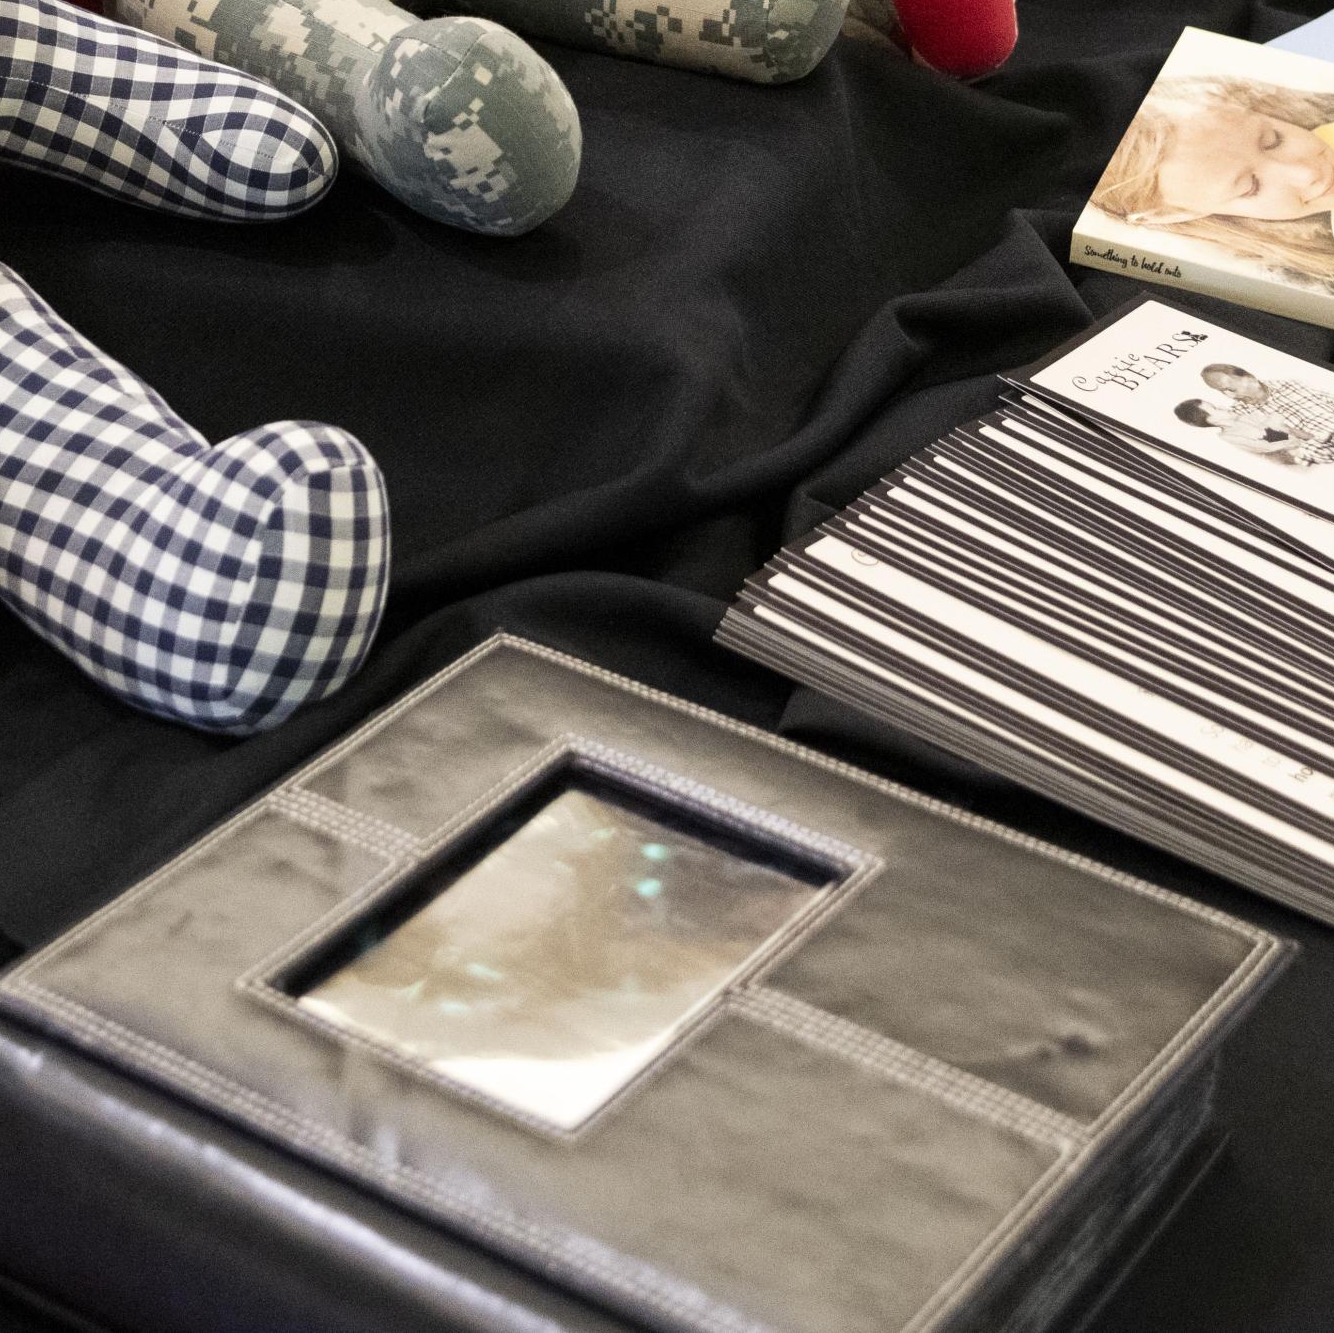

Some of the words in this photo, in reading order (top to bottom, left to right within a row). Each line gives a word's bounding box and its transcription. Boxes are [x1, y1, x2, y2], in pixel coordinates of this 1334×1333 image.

[1084, 245, 1127, 269] Something
[1131, 255, 1139, 267] to
[1141, 256, 1164, 275] hold
[1072, 353, 1140, 392] Carrie
[1110, 332, 1201, 391] BEARS
